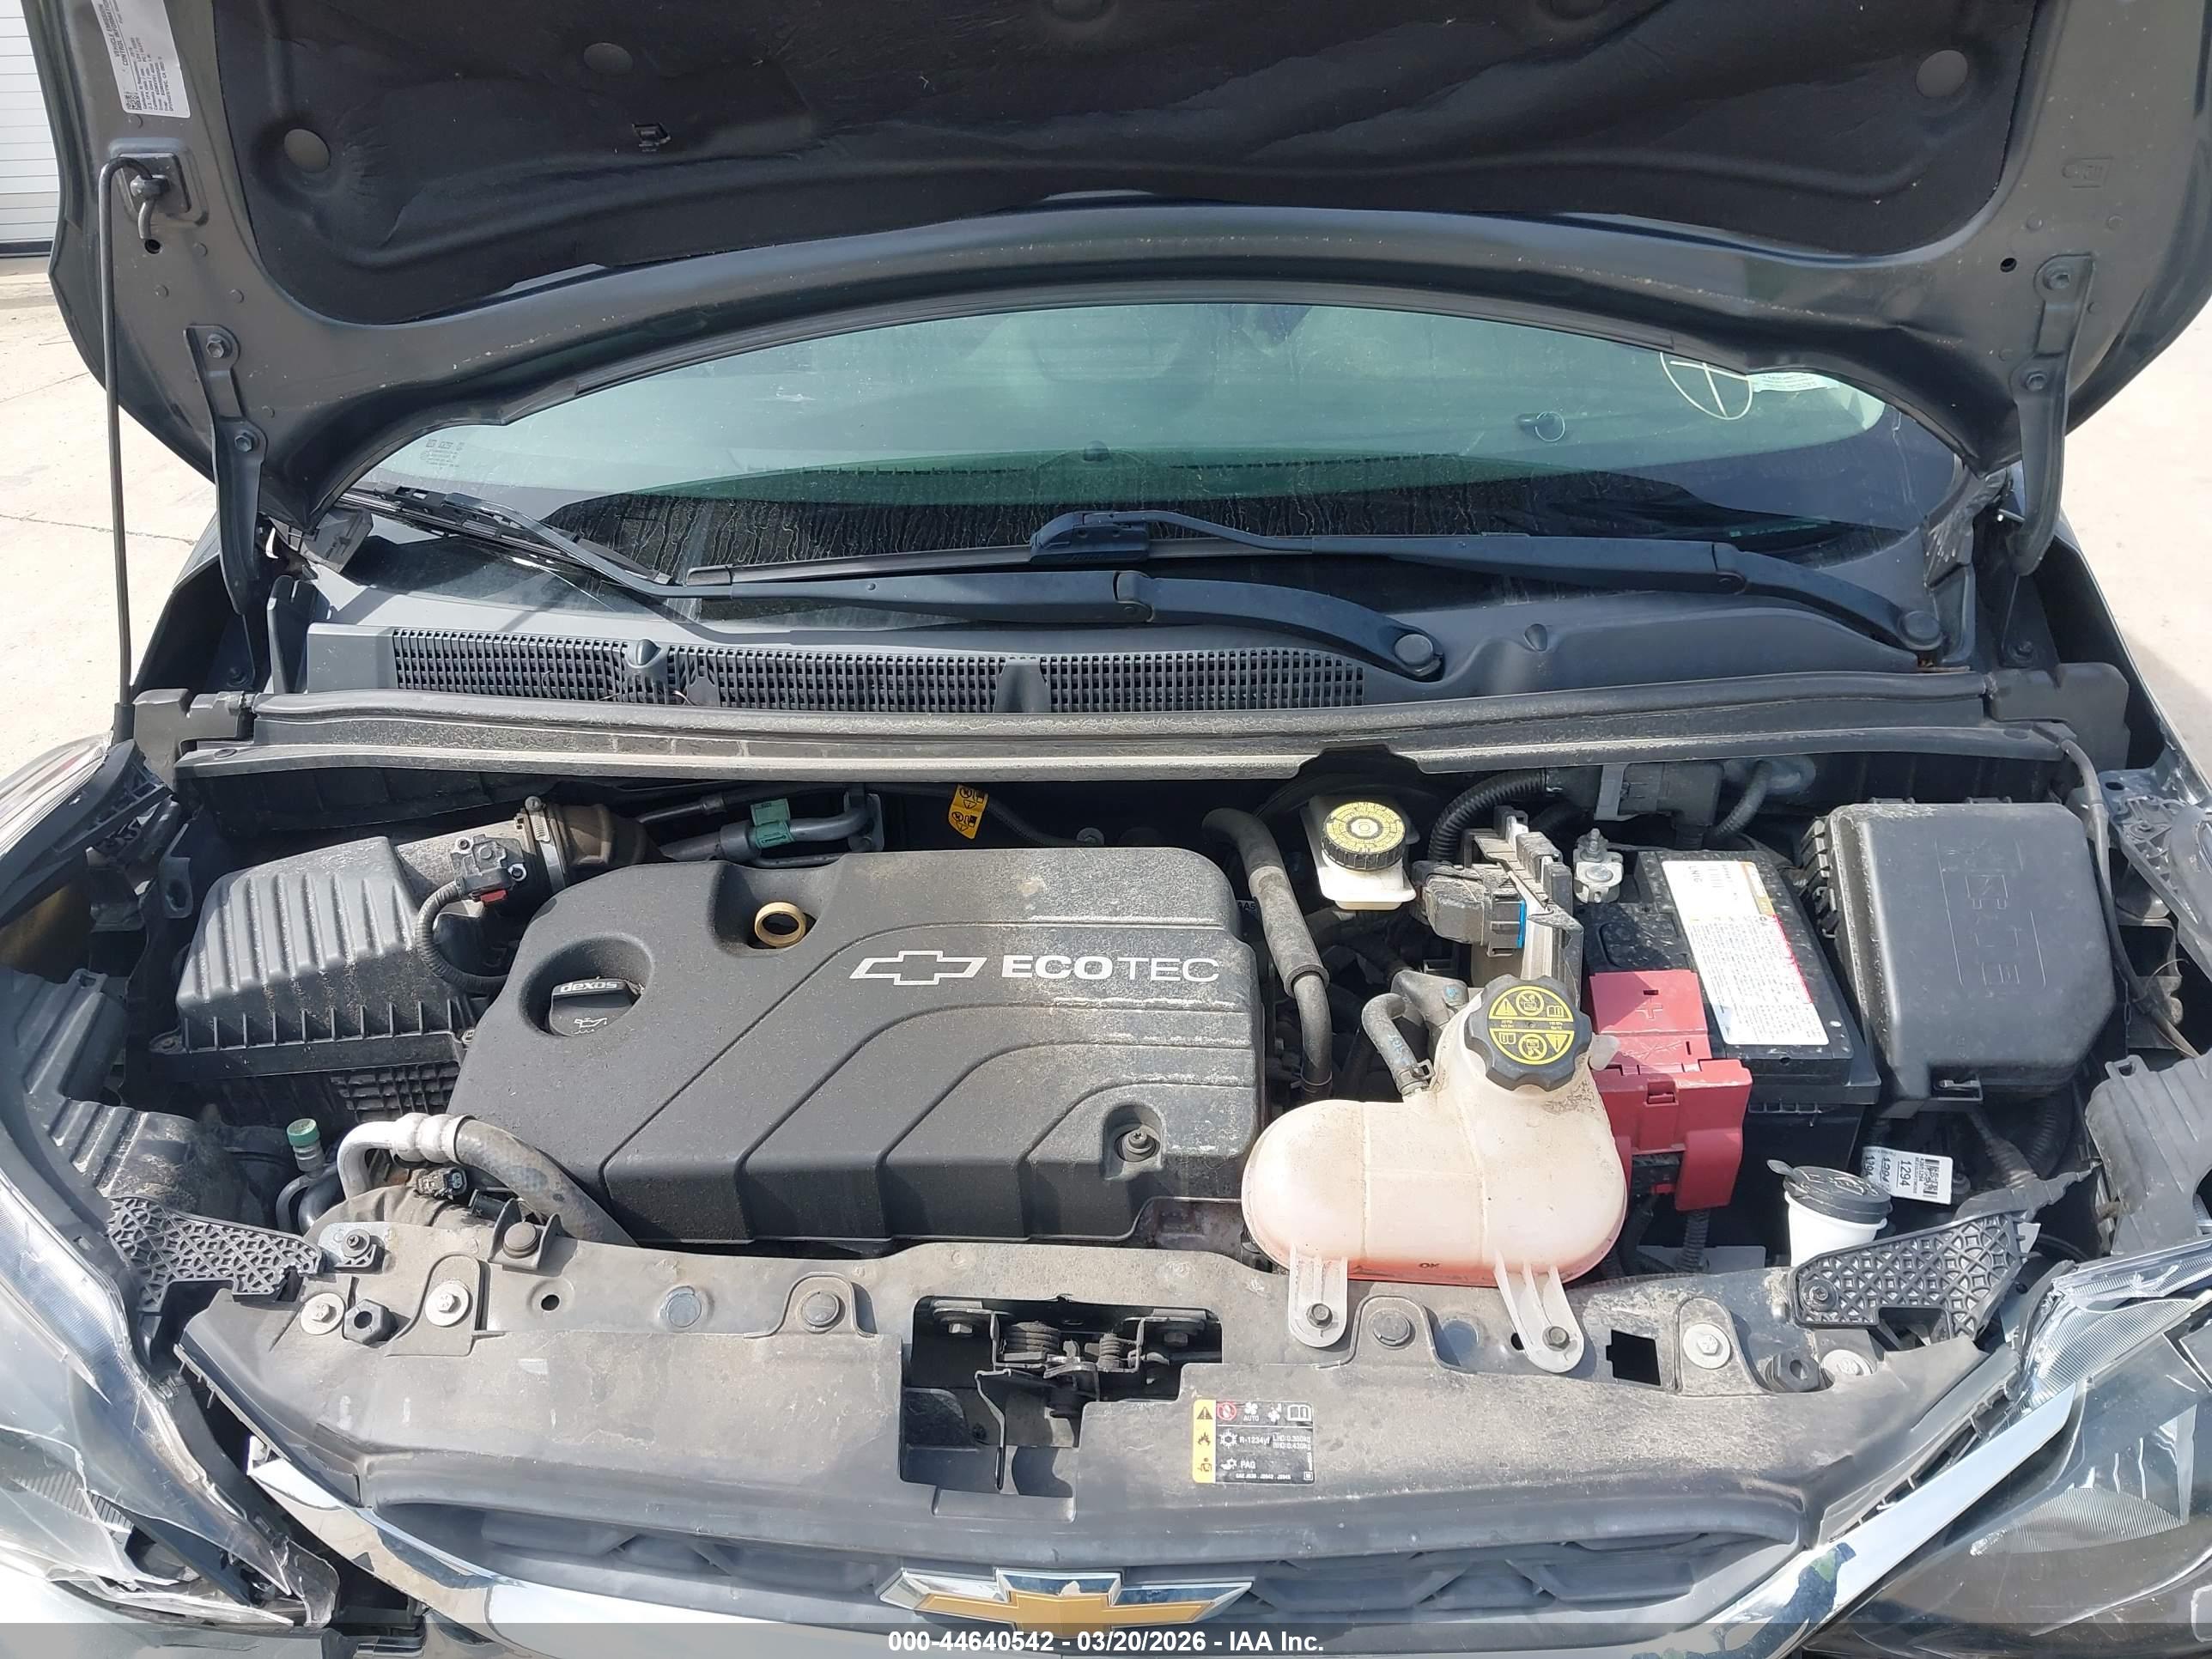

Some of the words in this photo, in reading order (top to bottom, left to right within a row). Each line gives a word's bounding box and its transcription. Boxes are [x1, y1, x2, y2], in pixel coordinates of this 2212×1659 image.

[107, 33, 119, 58] VEHICLE
[118, 40, 129, 66] CONTROL
[1001, 954, 1220, 982] ECOTEC
[560, 981, 617, 993] dexos
[1899, 1159, 1912, 1187] 1294
[1239, 1436, 1271, 1445] R-1234yf
[1240, 1460, 1256, 1469] PAG
